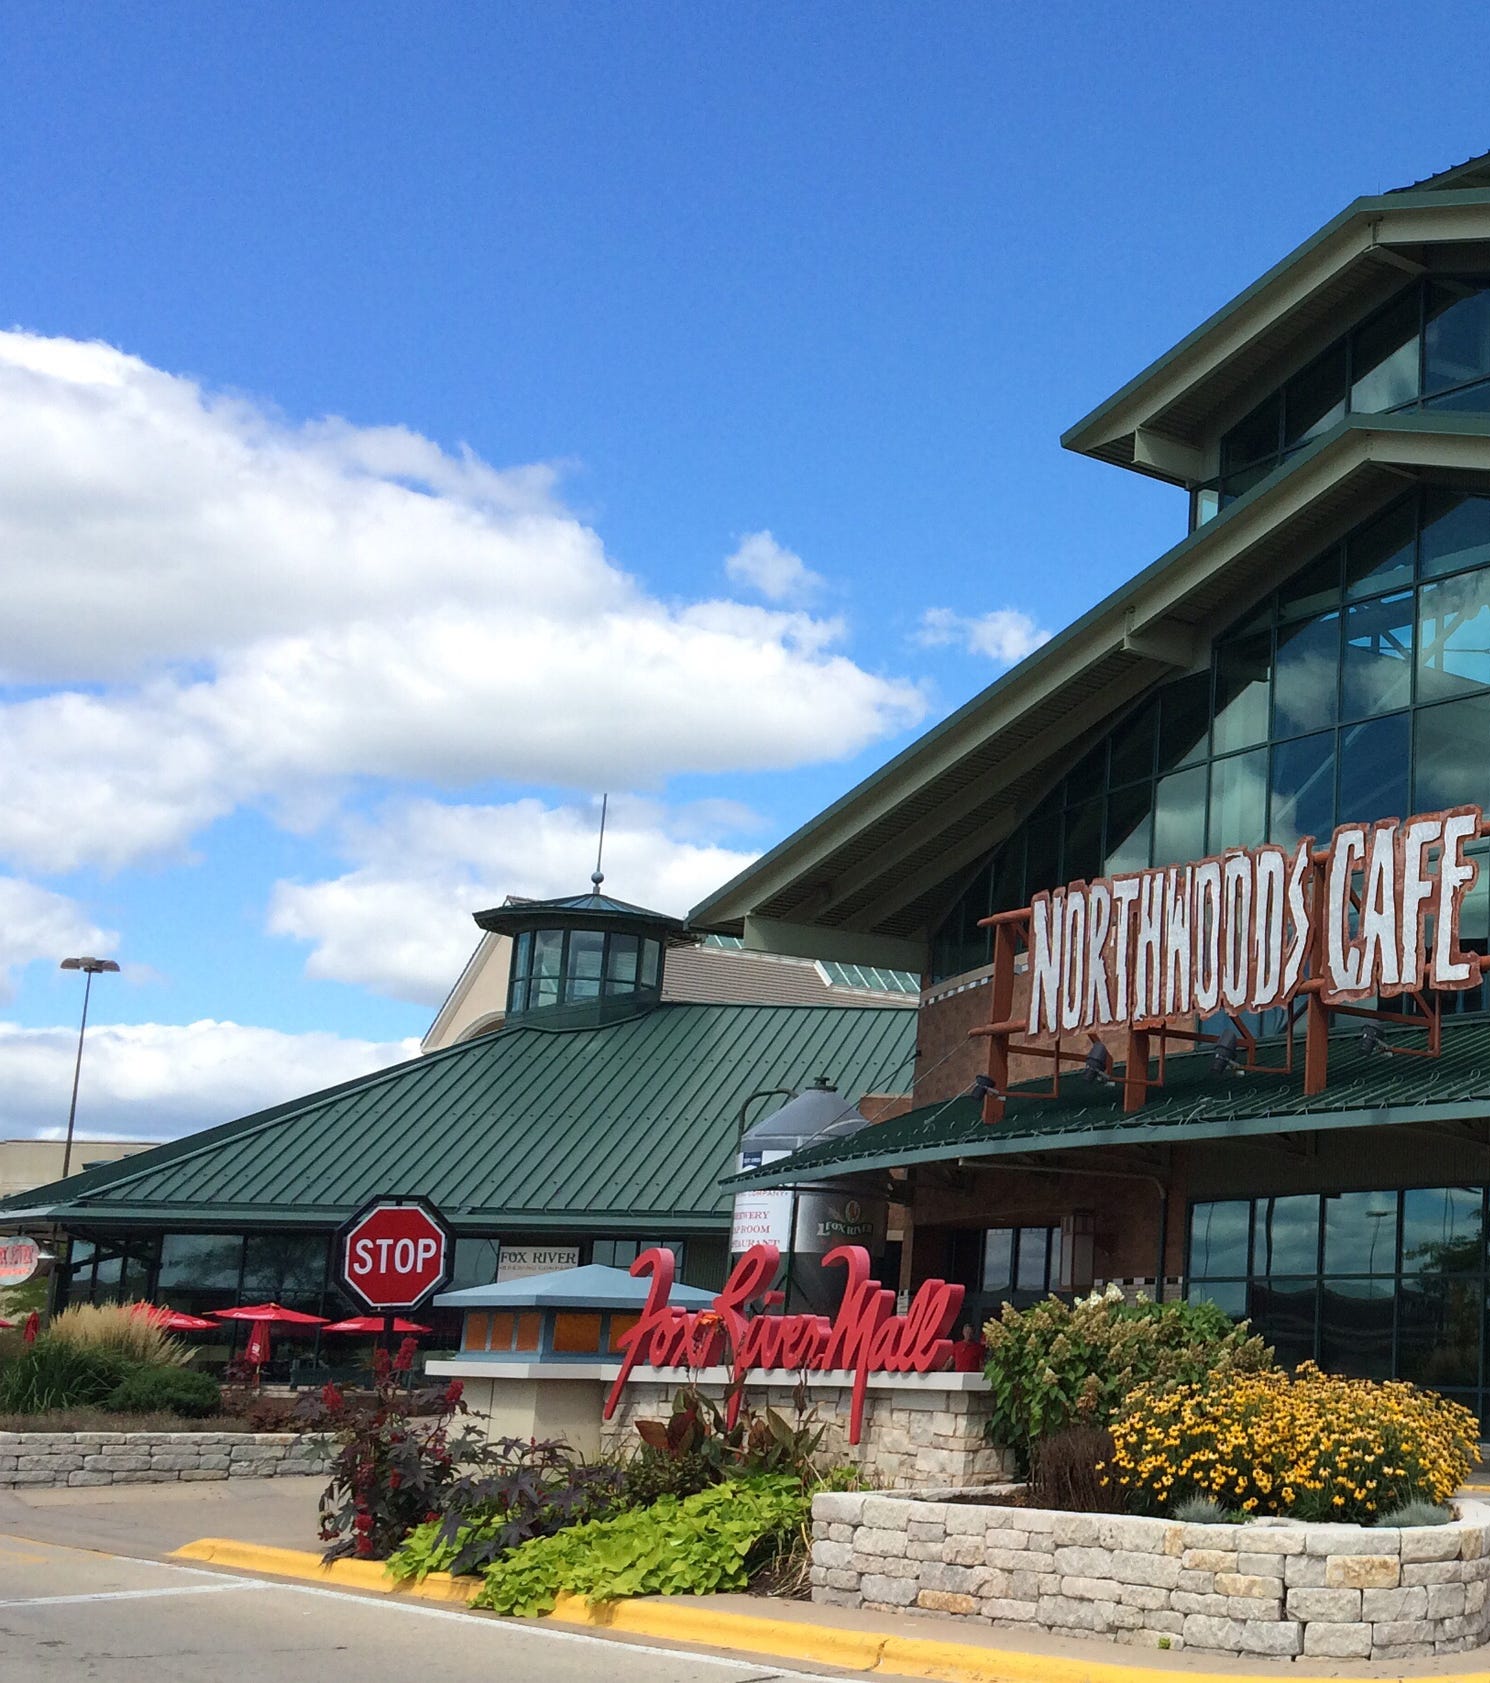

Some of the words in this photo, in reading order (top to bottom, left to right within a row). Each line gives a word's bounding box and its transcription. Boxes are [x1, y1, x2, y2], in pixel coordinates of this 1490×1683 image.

[1028, 842, 1310, 1036] NORTHWOODS
[1327, 813, 1478, 996] CAFE
[353, 1238, 437, 1275] STOP
[500, 1251, 527, 1264] FOX
[532, 1251, 577, 1264] RIVER
[603, 1247, 723, 1420] Fox
[712, 1244, 833, 1445] River
[821, 1245, 966, 1446] Mall
